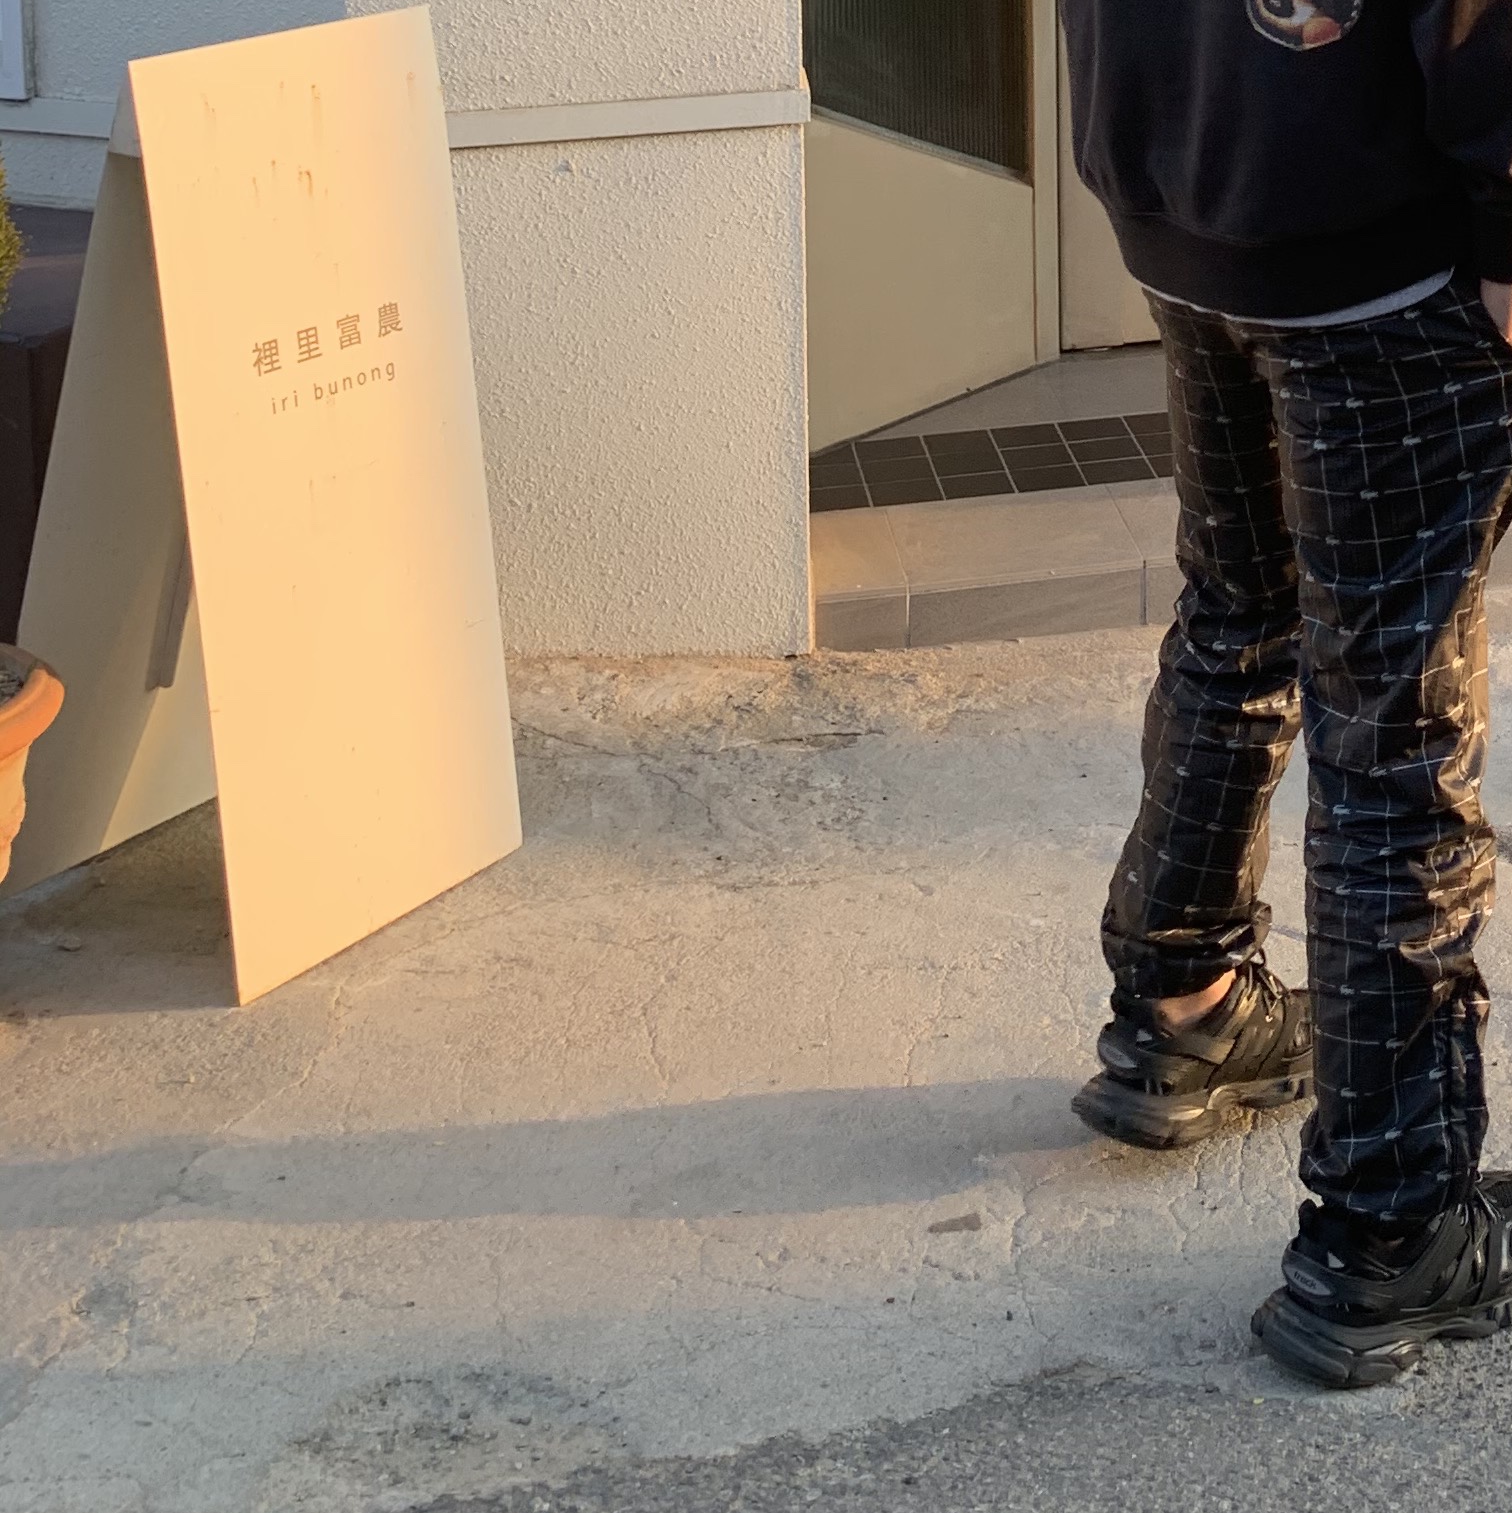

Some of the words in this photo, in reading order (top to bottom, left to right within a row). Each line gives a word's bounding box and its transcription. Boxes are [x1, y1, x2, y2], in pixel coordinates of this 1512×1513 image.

[252, 302, 403, 376] 裡里富農
[271, 390, 299, 415] iri
[313, 361, 396, 401] bunong
